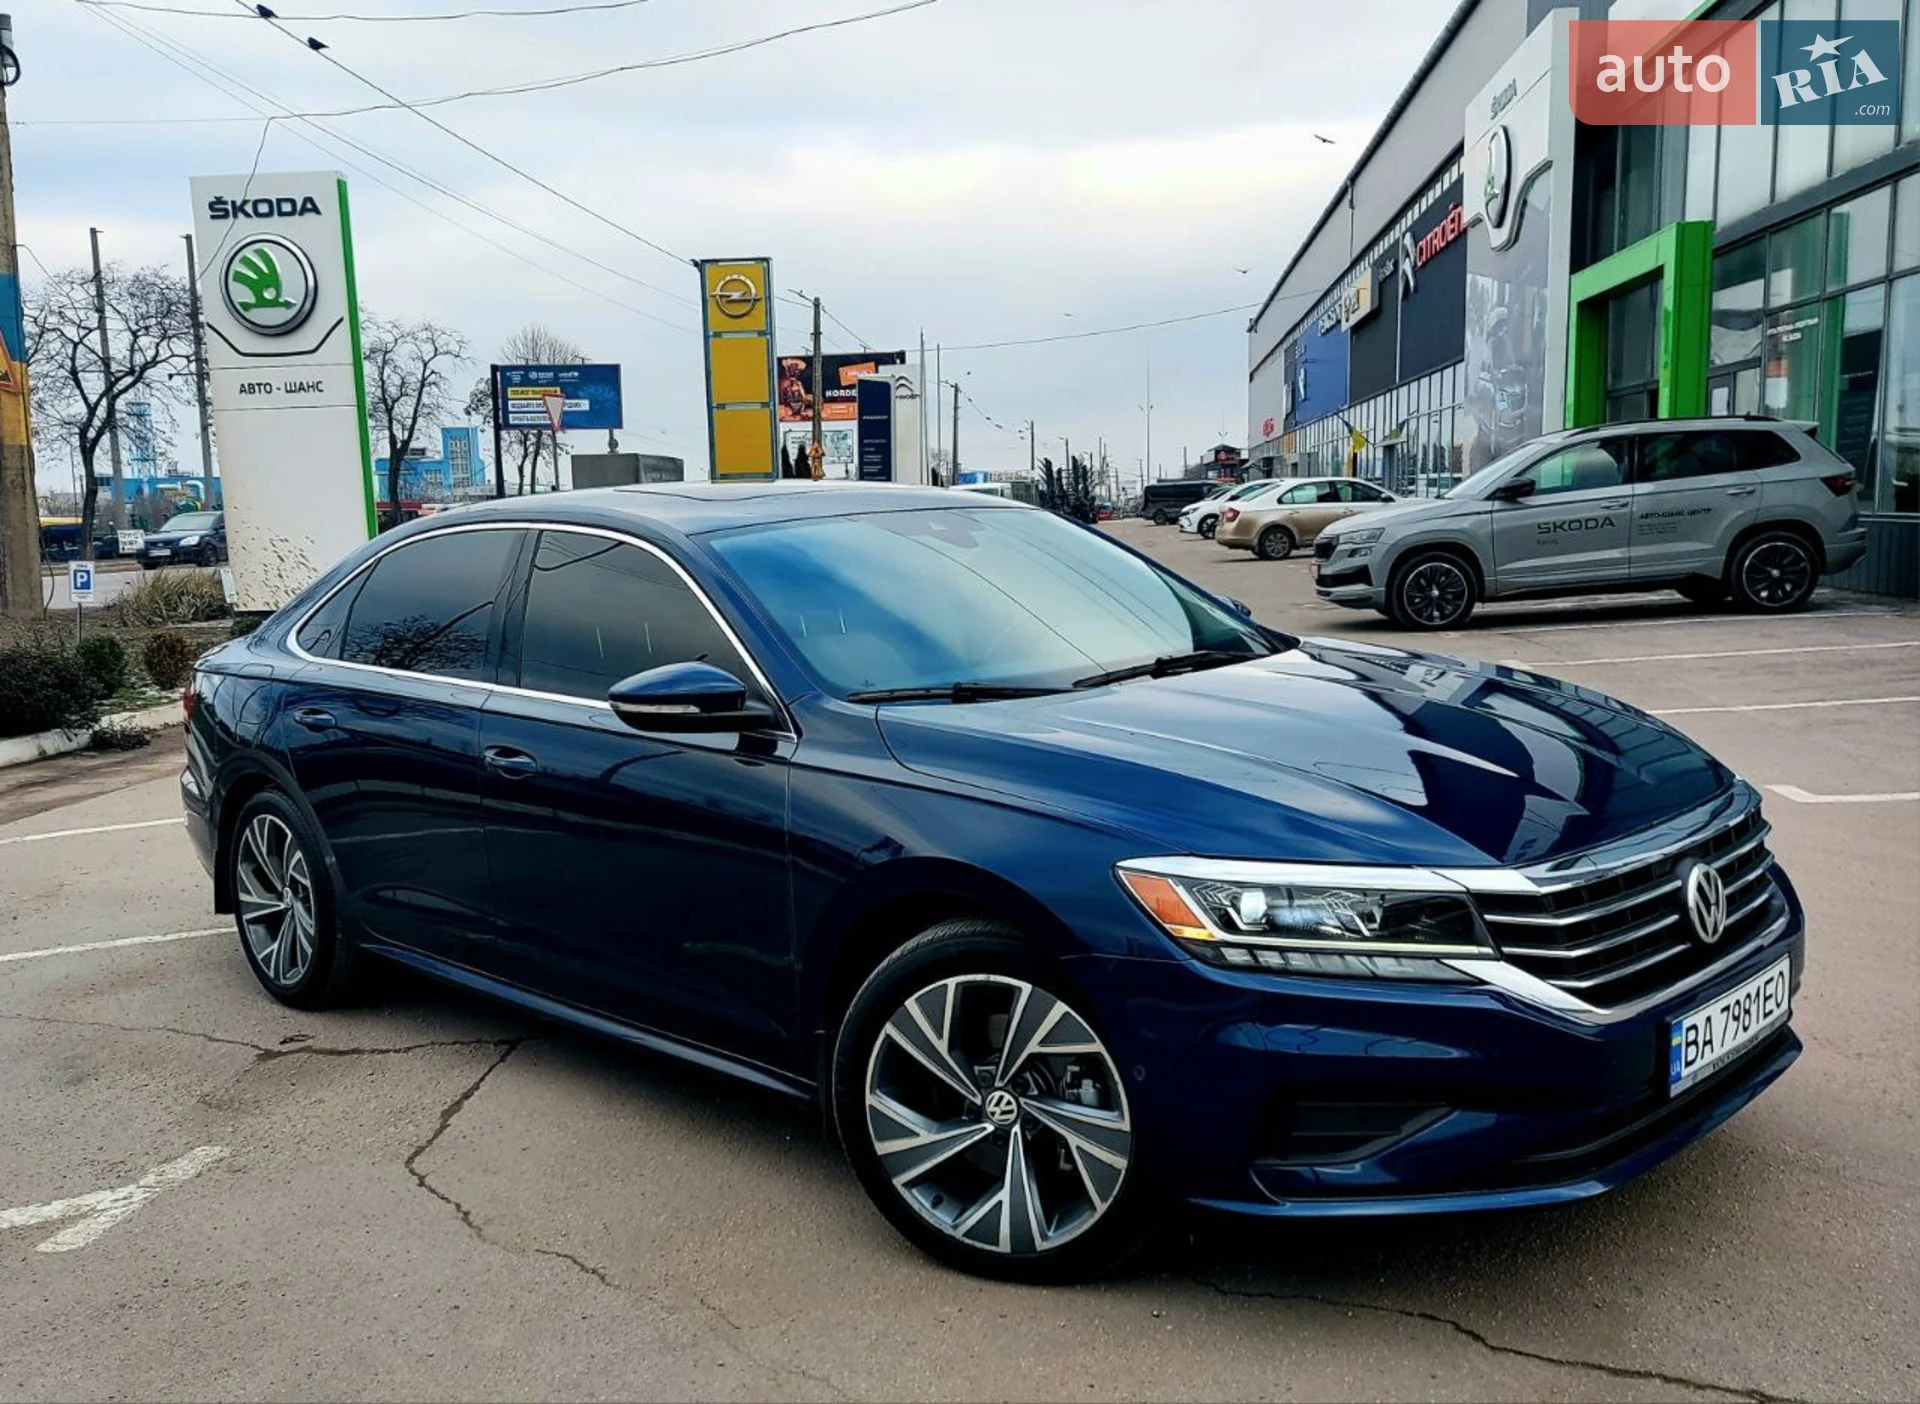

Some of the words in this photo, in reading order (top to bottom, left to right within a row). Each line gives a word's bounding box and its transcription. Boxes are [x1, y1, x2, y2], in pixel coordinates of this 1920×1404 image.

[208, 196, 322, 220] ŠKODA
[239, 382, 273, 395] АВТО
[284, 380, 324, 393] ШАНС
